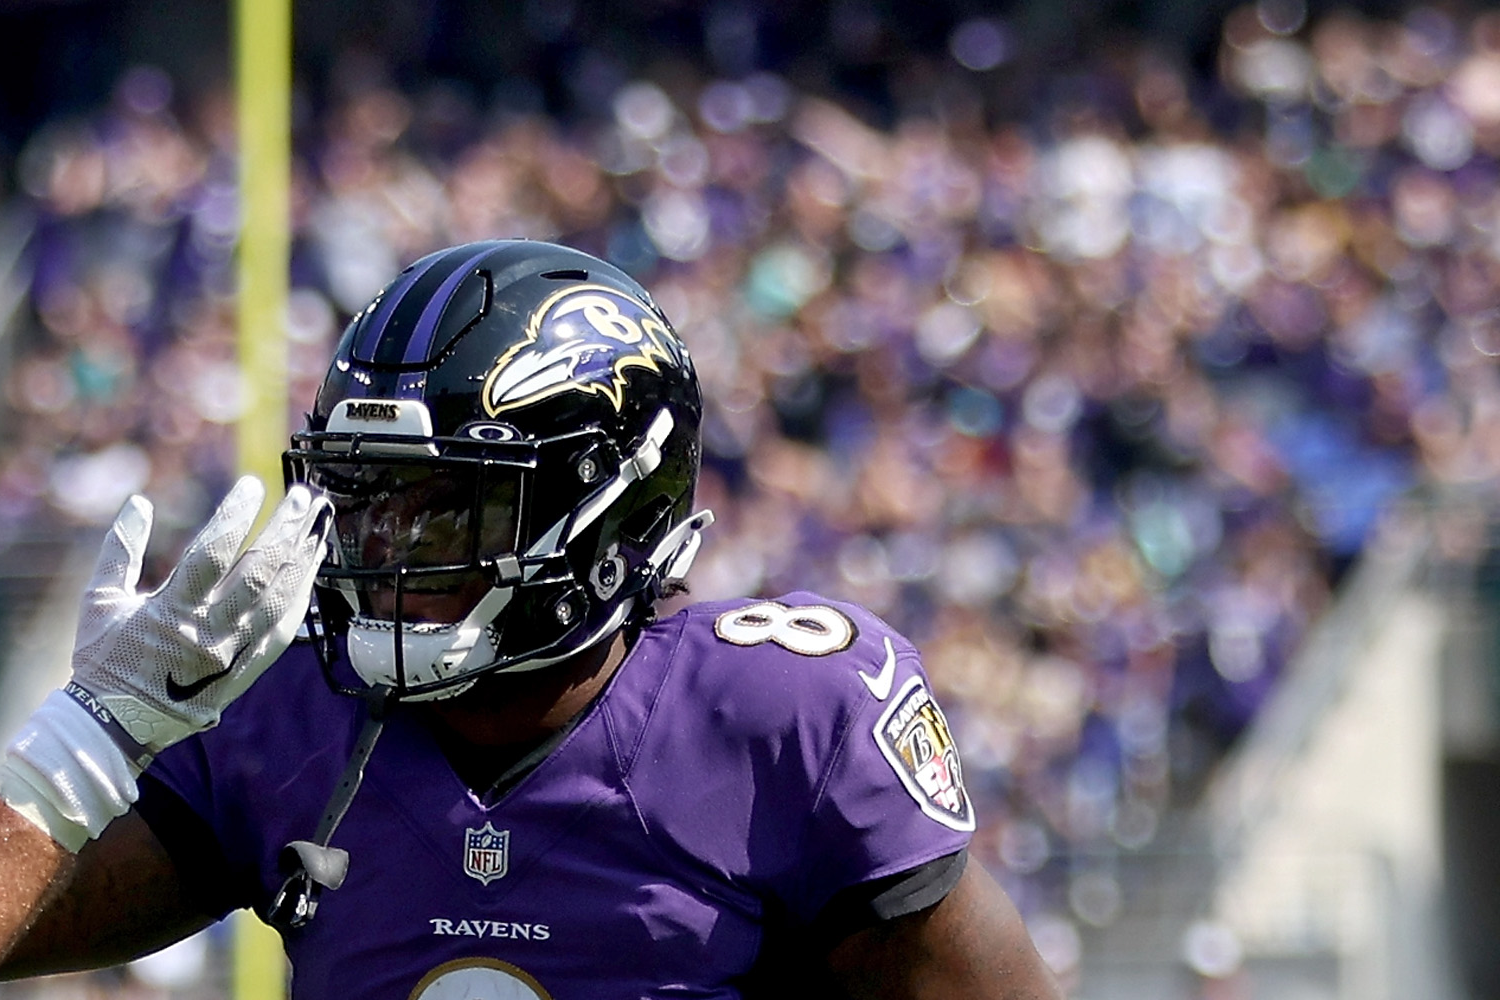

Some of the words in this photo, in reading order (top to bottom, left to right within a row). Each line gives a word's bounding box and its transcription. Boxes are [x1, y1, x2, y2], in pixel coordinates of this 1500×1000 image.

[346, 403, 398, 421] RAVENS
[714, 601, 854, 658] 8
[66, 683, 113, 724] VENS
[470, 850, 501, 873] NFL
[429, 918, 551, 941] RAVENS
